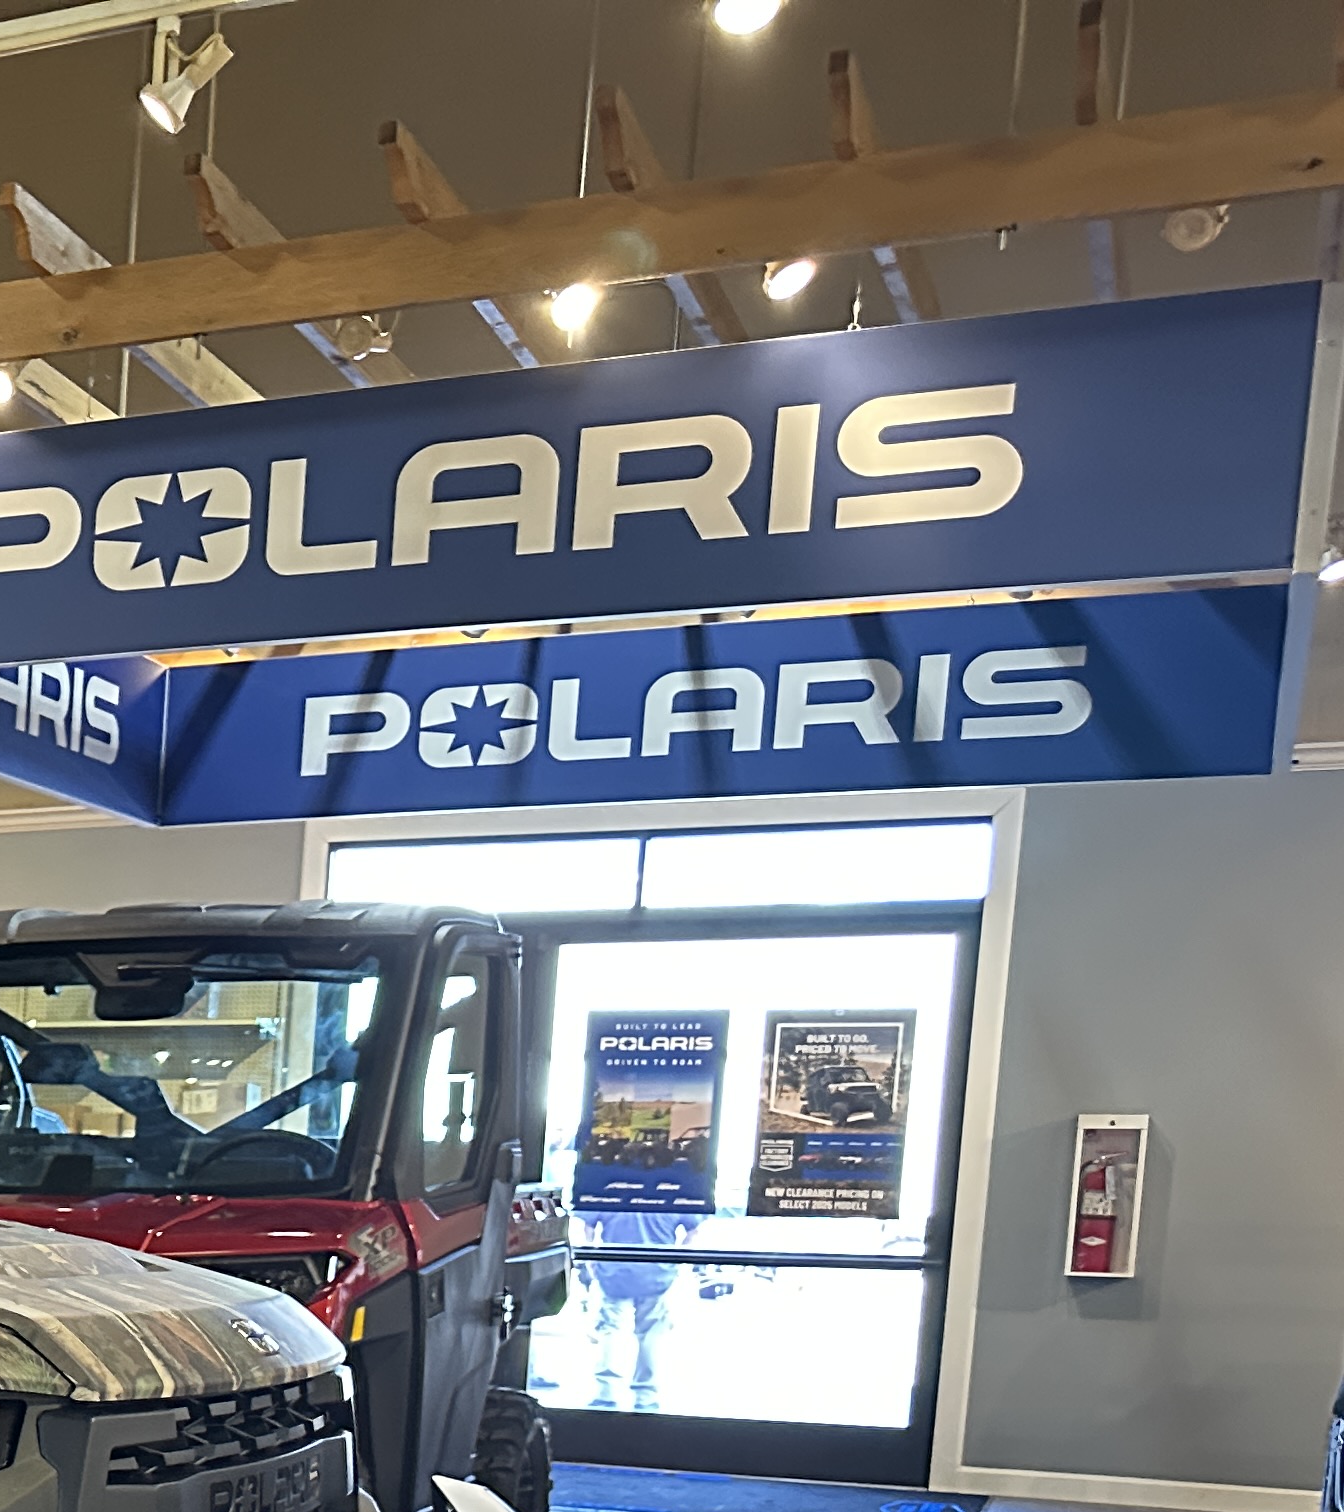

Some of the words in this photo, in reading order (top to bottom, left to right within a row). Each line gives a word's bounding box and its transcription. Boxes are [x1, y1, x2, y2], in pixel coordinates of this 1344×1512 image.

[301, 645, 1094, 777] POLARIS
[672, 1022, 702, 1030] LEAD
[599, 1036, 714, 1051] POLARIS
[837, 1034, 851, 1043] TO
[653, 1058, 667, 1066] TO
[786, 1187, 834, 1199] CLEARANCE
[778, 1199, 810, 1210] SELECT
[833, 1201, 868, 1211] MODELS
